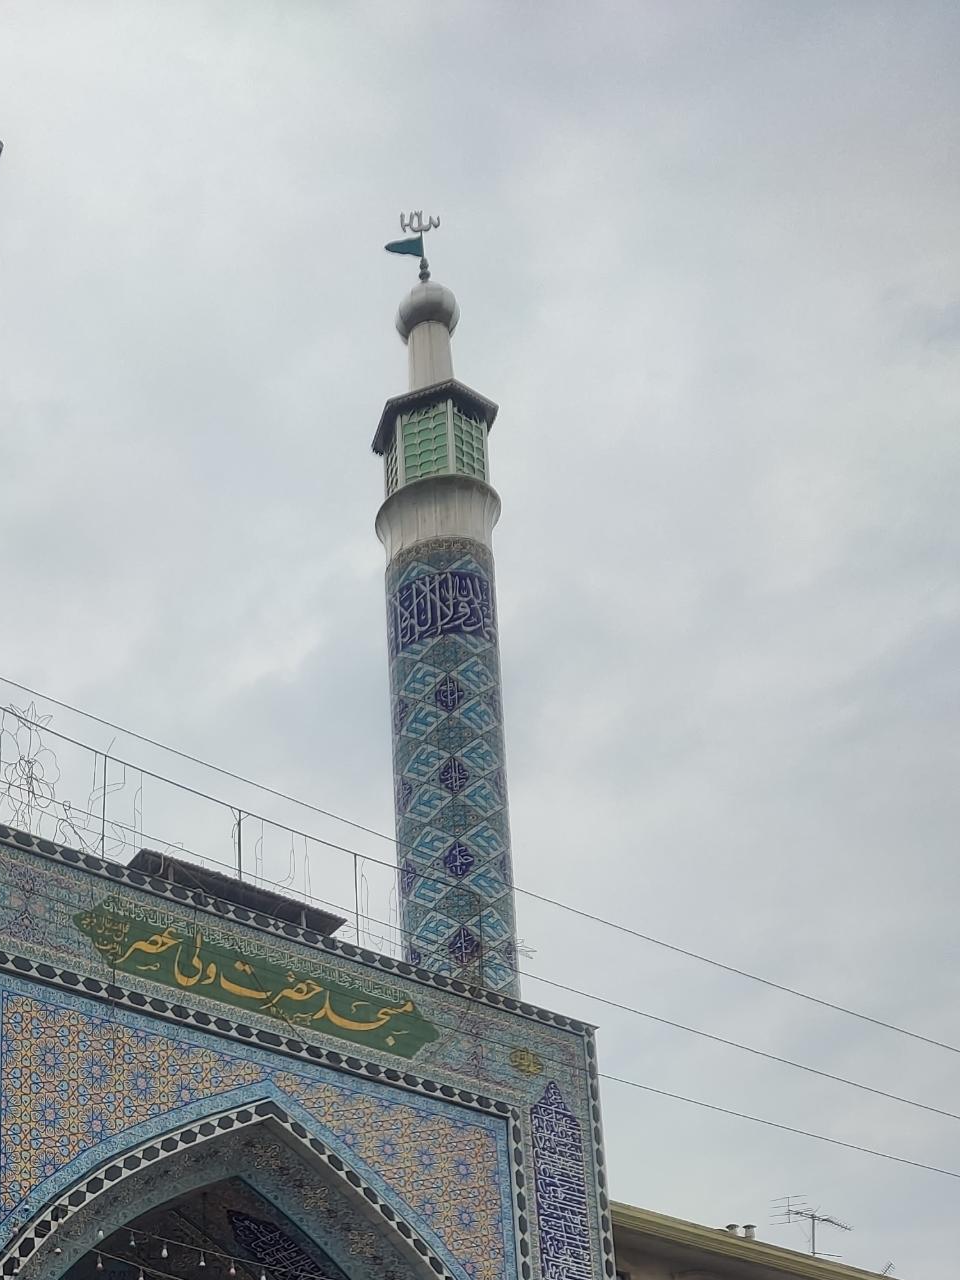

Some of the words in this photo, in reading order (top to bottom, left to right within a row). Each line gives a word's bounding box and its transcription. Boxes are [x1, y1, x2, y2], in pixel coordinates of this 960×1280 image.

[114, 927, 184, 964] عصر
[174, 931, 217, 987] ولی
[220, 960, 325, 1010] حضرت
[312, 990, 414, 1047] مسجد
